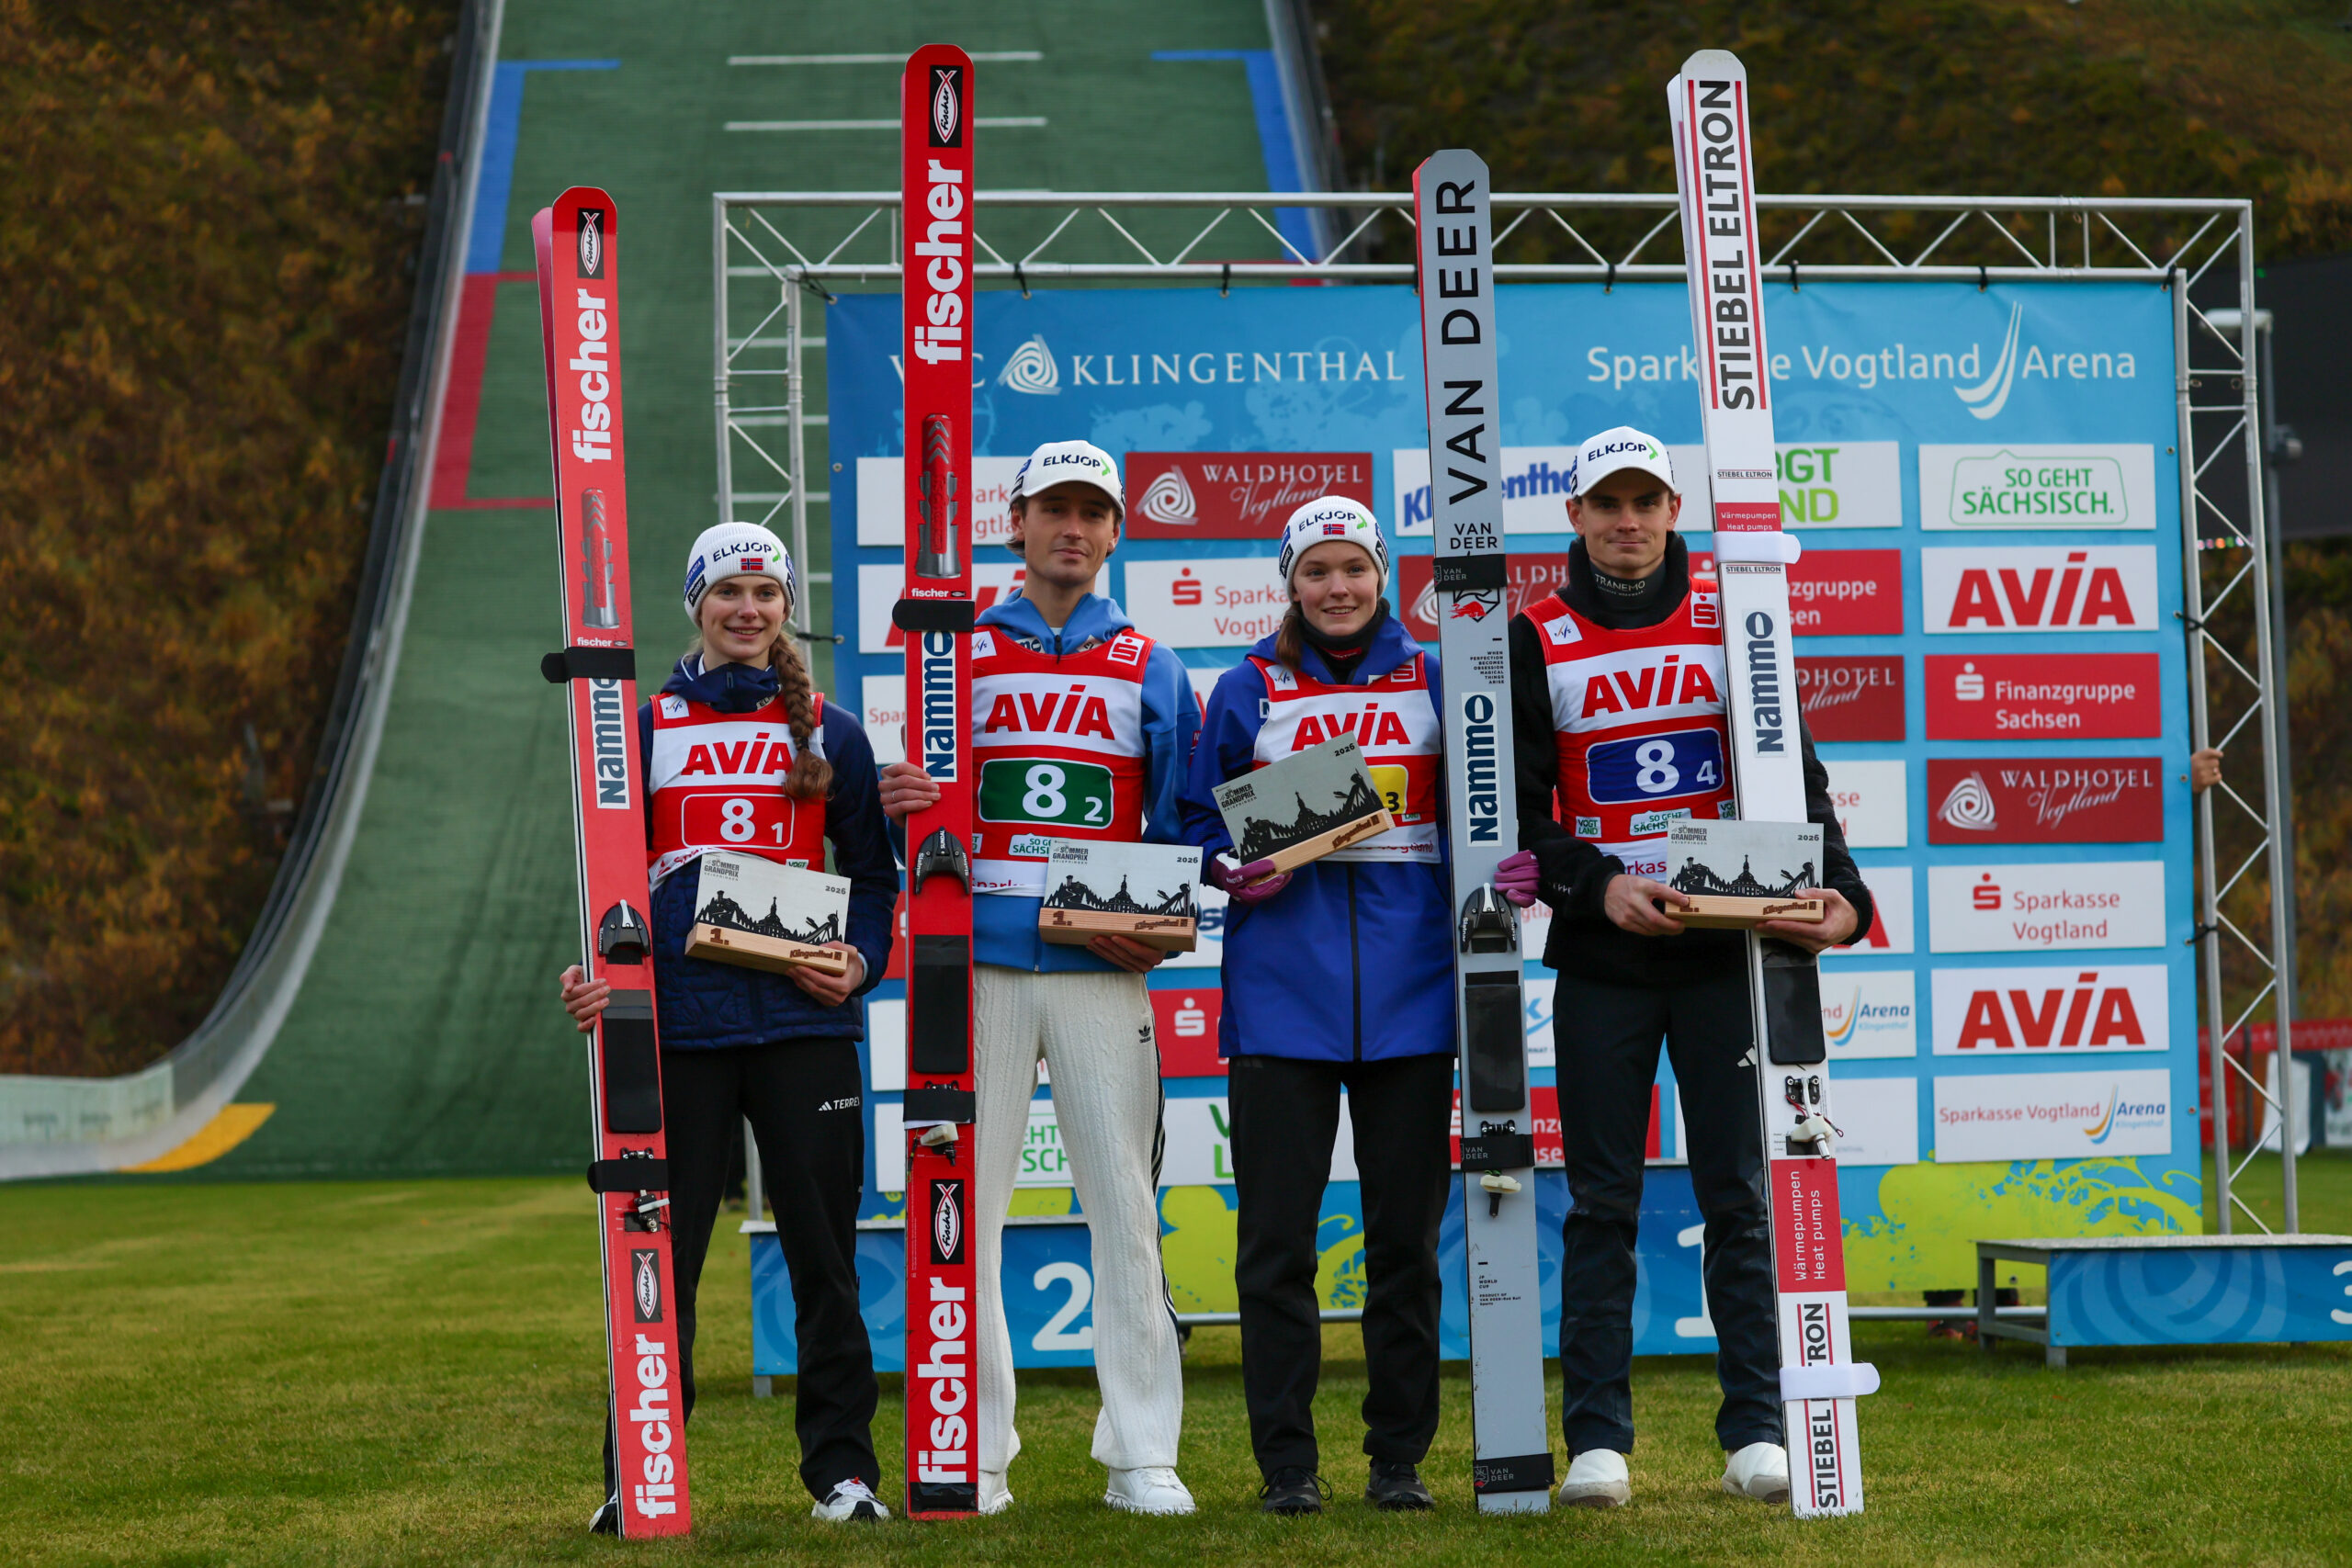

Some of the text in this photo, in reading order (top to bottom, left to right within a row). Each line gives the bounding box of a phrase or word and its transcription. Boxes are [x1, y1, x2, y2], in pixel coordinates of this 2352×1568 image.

[939, 87, 950, 131] fischer
[1699, 80, 1756, 411] STIEBEL ELTRON
[914, 159, 964, 365] fischer
[1436, 180, 1488, 505] VAN DEER
[570, 288, 612, 463] fischer
[1073, 351, 1406, 385] KLINGENTHAL
[1588, 344, 2136, 390] Sparke Vogtland Arena
[1203, 464, 1364, 484] WALDHOTEL
[2006, 468, 2094, 488] SO GEHT
[1962, 485, 2114, 515] SÄCHSISCH.
[1454, 523, 1491, 536] VAN
[1450, 536, 1498, 549] DEER
[911, 588, 949, 598] fischer
[1595, 573, 1645, 592] TRANEMO
[1789, 578, 1877, 601] zgruppe
[1215, 583, 1290, 610] Sparka
[1214, 615, 1280, 640] Vogtla
[577, 637, 613, 647] fischer
[1746, 611, 1784, 754] Nammo
[1796, 667, 1896, 686] DHOTEL
[1996, 680, 2136, 705] Finanzgruppe
[923, 631, 956, 778] Nammo
[1996, 708, 2081, 729] Sachsen
[1335, 742, 1356, 757] 2026
[1464, 694, 1499, 844] Nammo
[1635, 739, 1717, 794] 8 4
[2000, 770, 2154, 788] WALDHOTEL
[1022, 764, 1103, 822] 8 2
[1221, 790, 1256, 808] GRANDPRIX
[1385, 792, 1400, 813] 3
[720, 798, 784, 843] 8 1
[1577, 818, 1597, 827] VOGT
[1577, 827, 1599, 835] LAND
[1670, 832, 1707, 841] GRANDPRIX
[1052, 852, 1089, 862] GRANDPRIX
[825, 885, 847, 896] 2026
[2013, 890, 2120, 913] Sparkasse
[709, 928, 729, 946] 1.
[2013, 919, 2109, 945] Vogtland
[1860, 1003, 1910, 1018] Arena
[1939, 1102, 2166, 1125] Sparkasse Vogtland Arena
[1465, 1152, 1488, 1160] DEER
[1791, 1170, 1807, 1281] Wärmepumpen
[1811, 1190, 1826, 1280] Heat pumps
[1032, 1261, 1093, 1351] 2
[918, 1277, 967, 1483] fischer
[629, 1334, 677, 1519] fischer
[1814, 1409, 1838, 1508] STIEBEL
[1490, 1473, 1514, 1482] DEER
